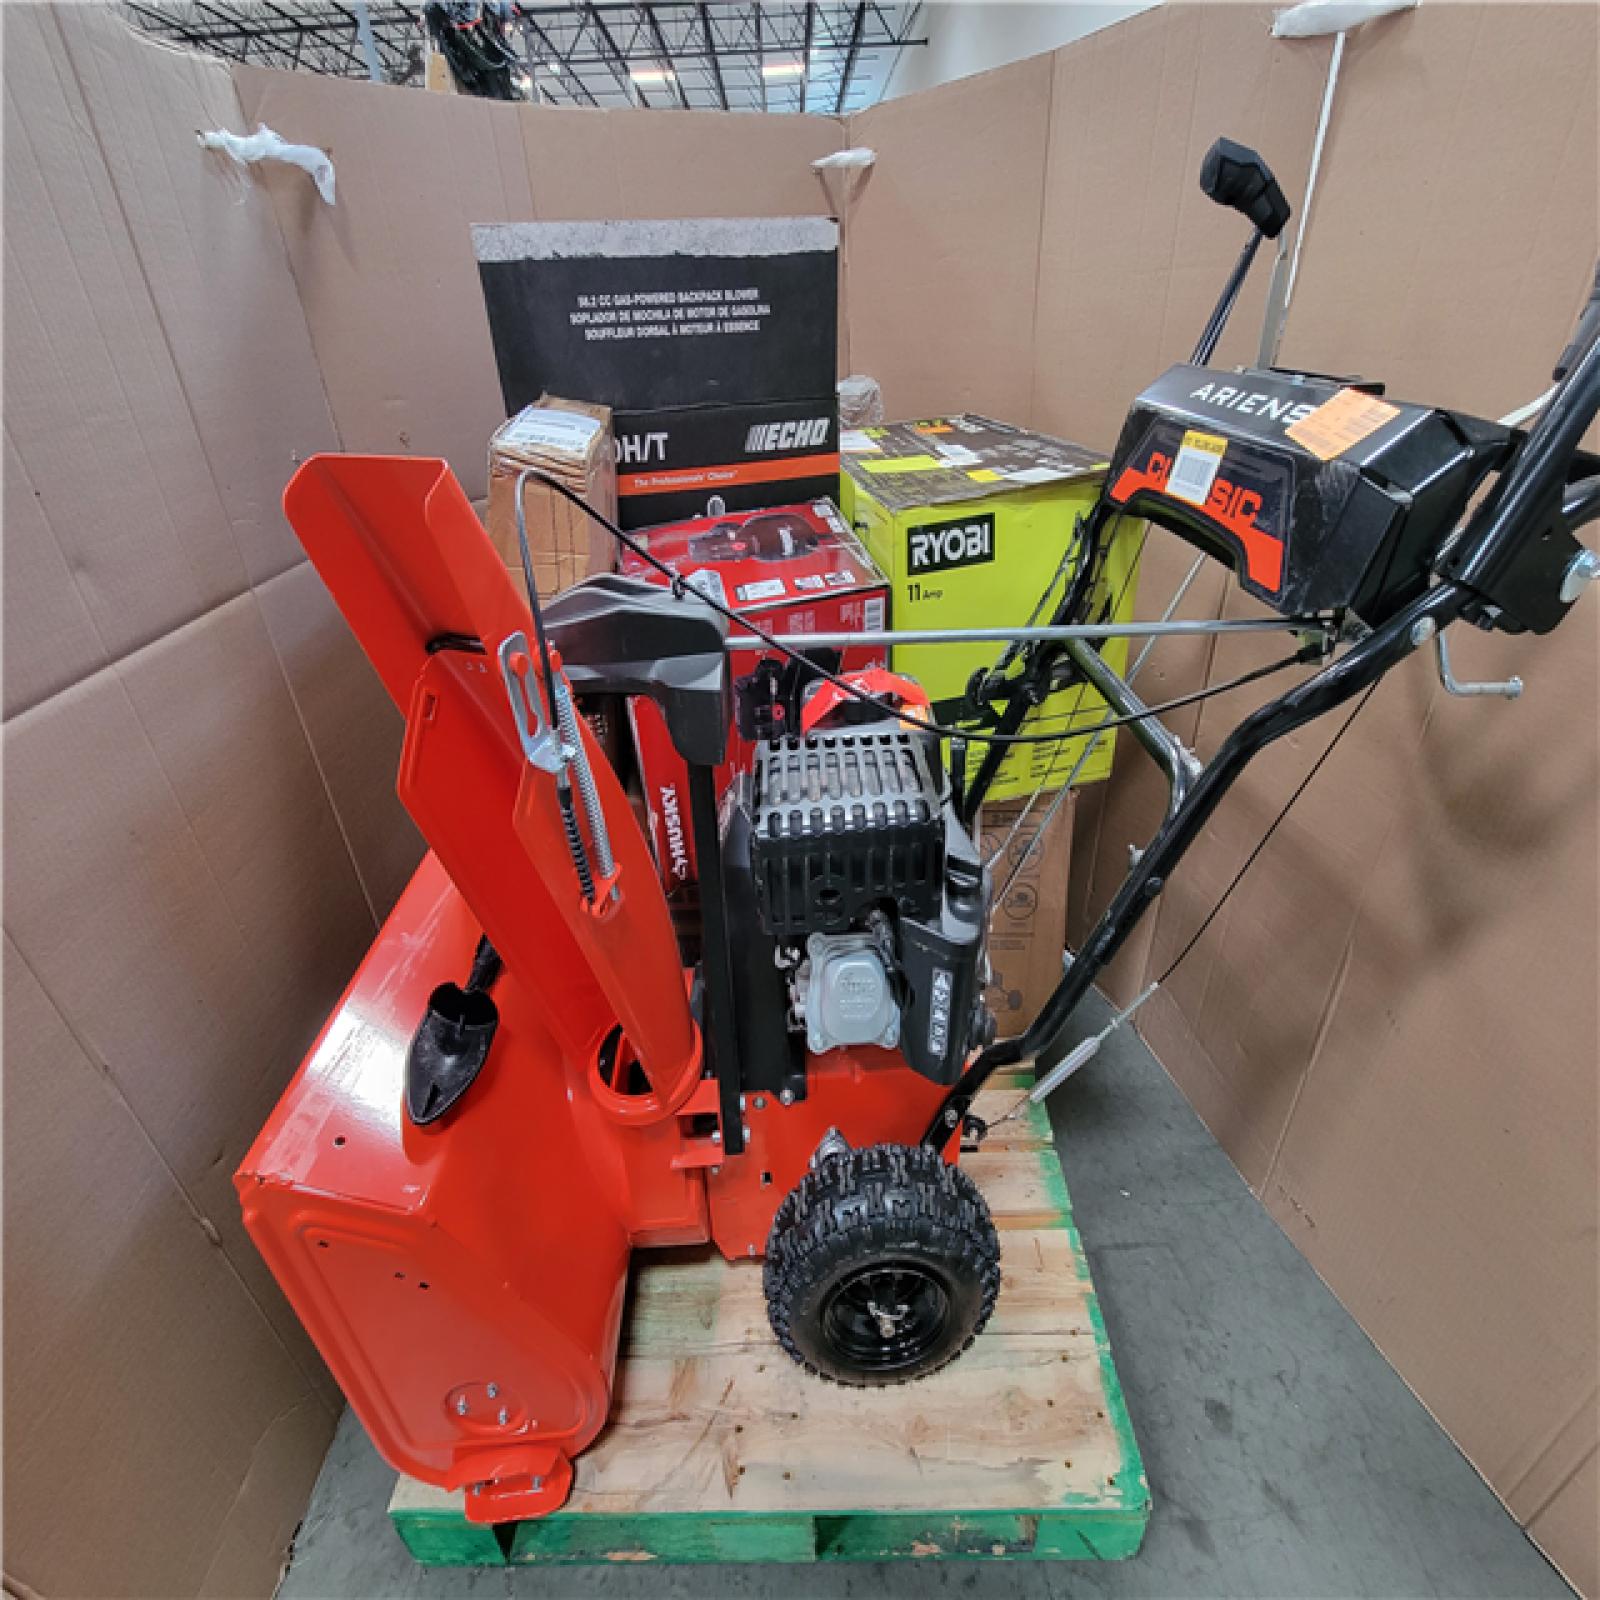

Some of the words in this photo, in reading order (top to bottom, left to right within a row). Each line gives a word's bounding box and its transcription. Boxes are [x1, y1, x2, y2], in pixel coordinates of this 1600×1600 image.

[724, 288, 759, 301] BLOWER
[762, 417, 830, 450] ECHO
[910, 521, 992, 567] RYOBI
[906, 583, 921, 603] 11
